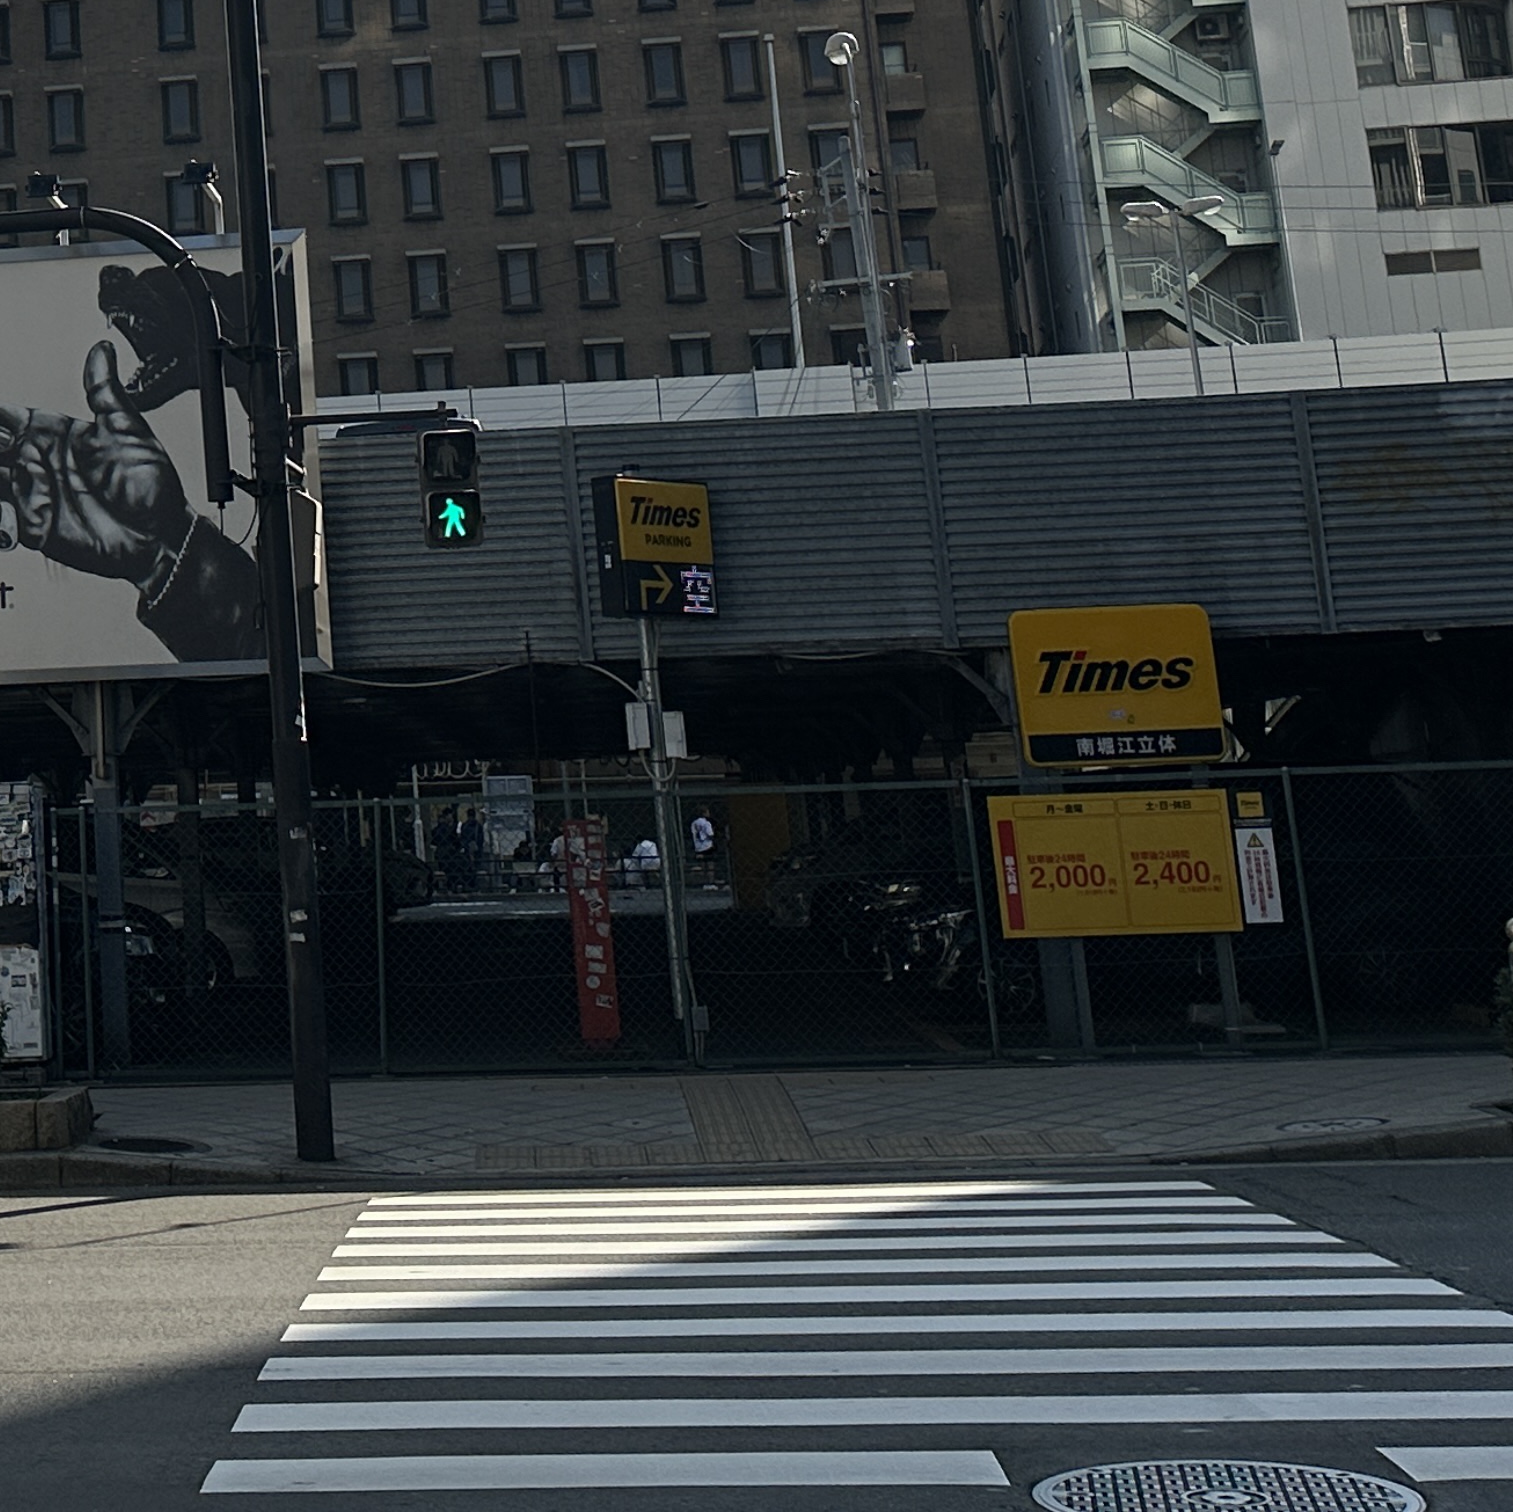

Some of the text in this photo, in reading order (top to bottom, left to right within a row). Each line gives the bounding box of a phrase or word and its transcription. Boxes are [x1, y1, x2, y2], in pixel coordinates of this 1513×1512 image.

[630, 496, 701, 529] Times
[644, 533, 692, 548] PARKING
[1039, 650, 1194, 694] Times
[1076, 734, 1177, 757] 南堀江立体
